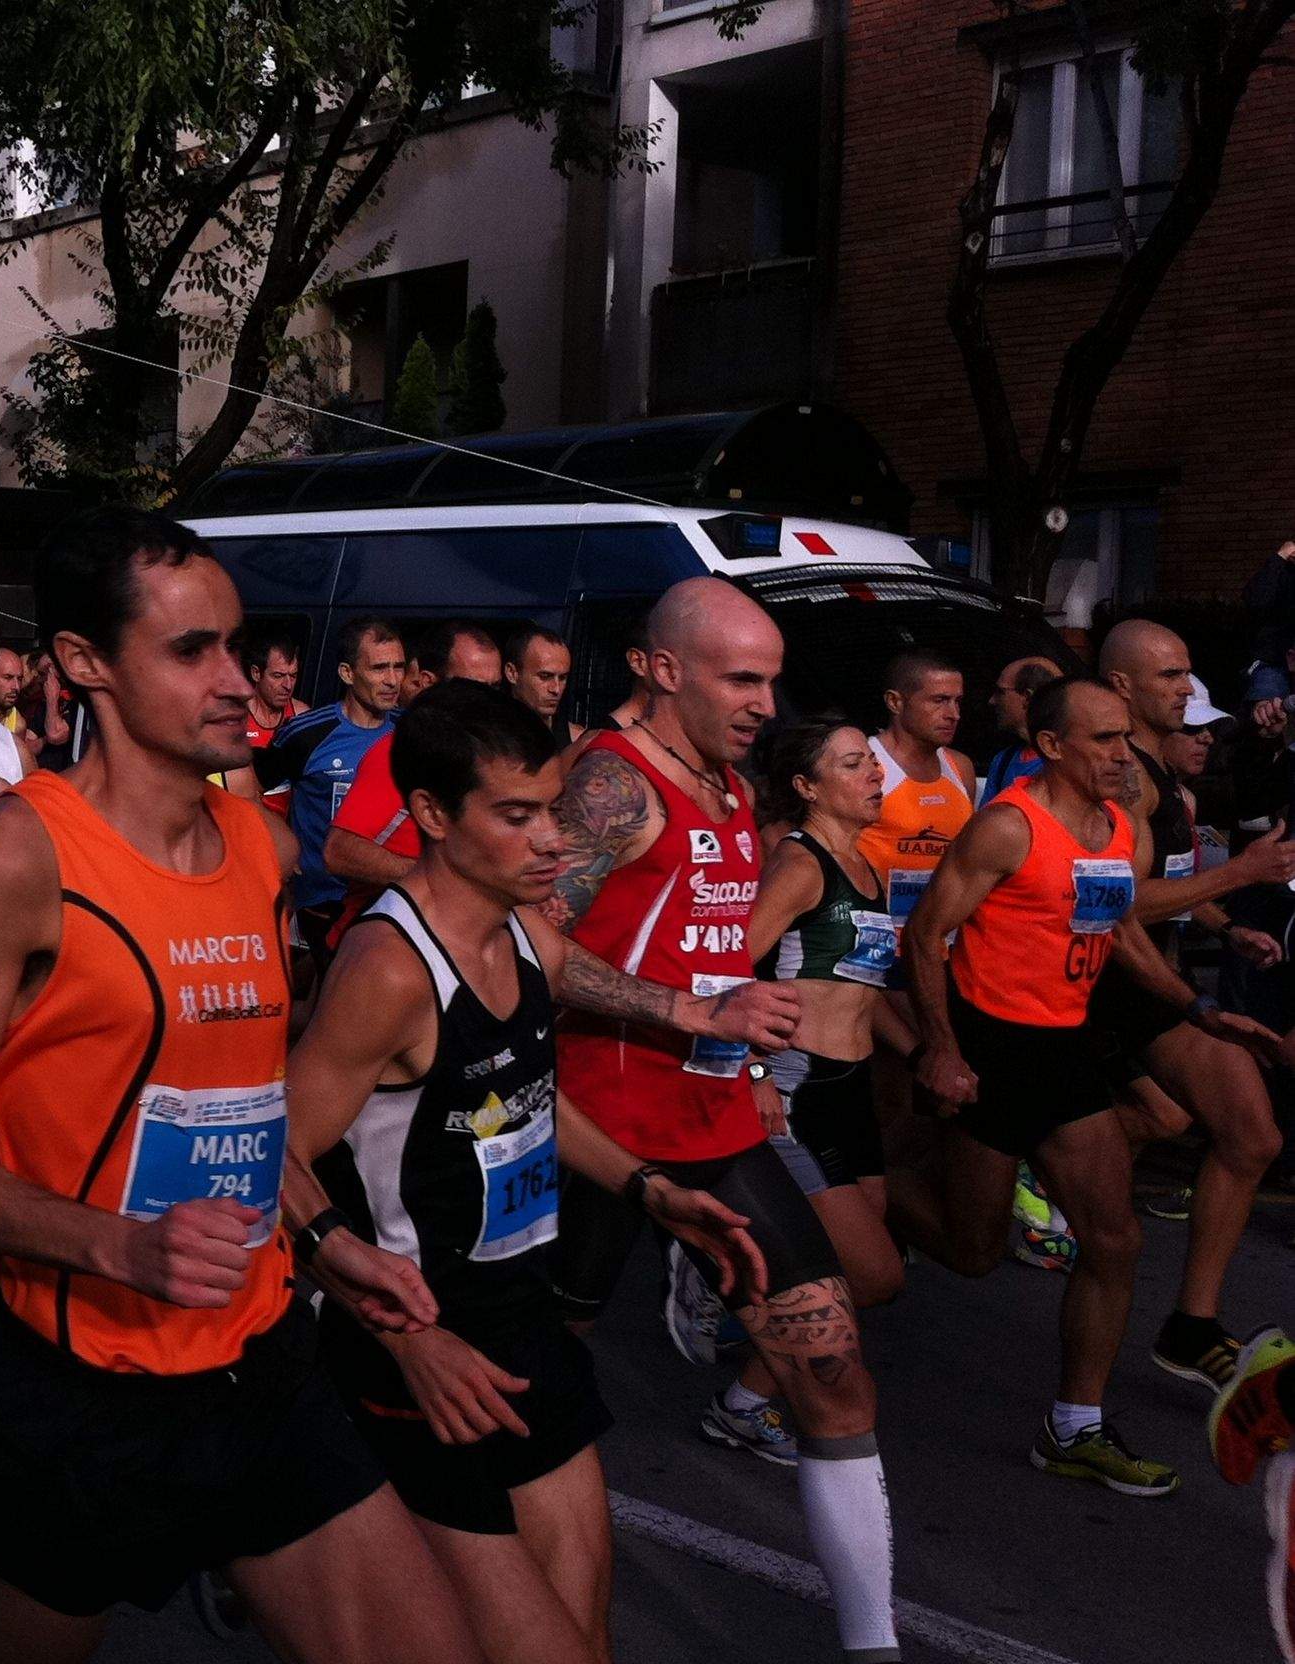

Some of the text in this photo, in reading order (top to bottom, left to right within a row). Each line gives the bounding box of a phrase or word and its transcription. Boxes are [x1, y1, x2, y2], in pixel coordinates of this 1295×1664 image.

[1083, 885, 1127, 908] 1768
[169, 934, 266, 966] MARC78
[189, 1130, 269, 1165] MARC
[207, 1173, 252, 1198] 794
[501, 1154, 556, 1215] 1762
